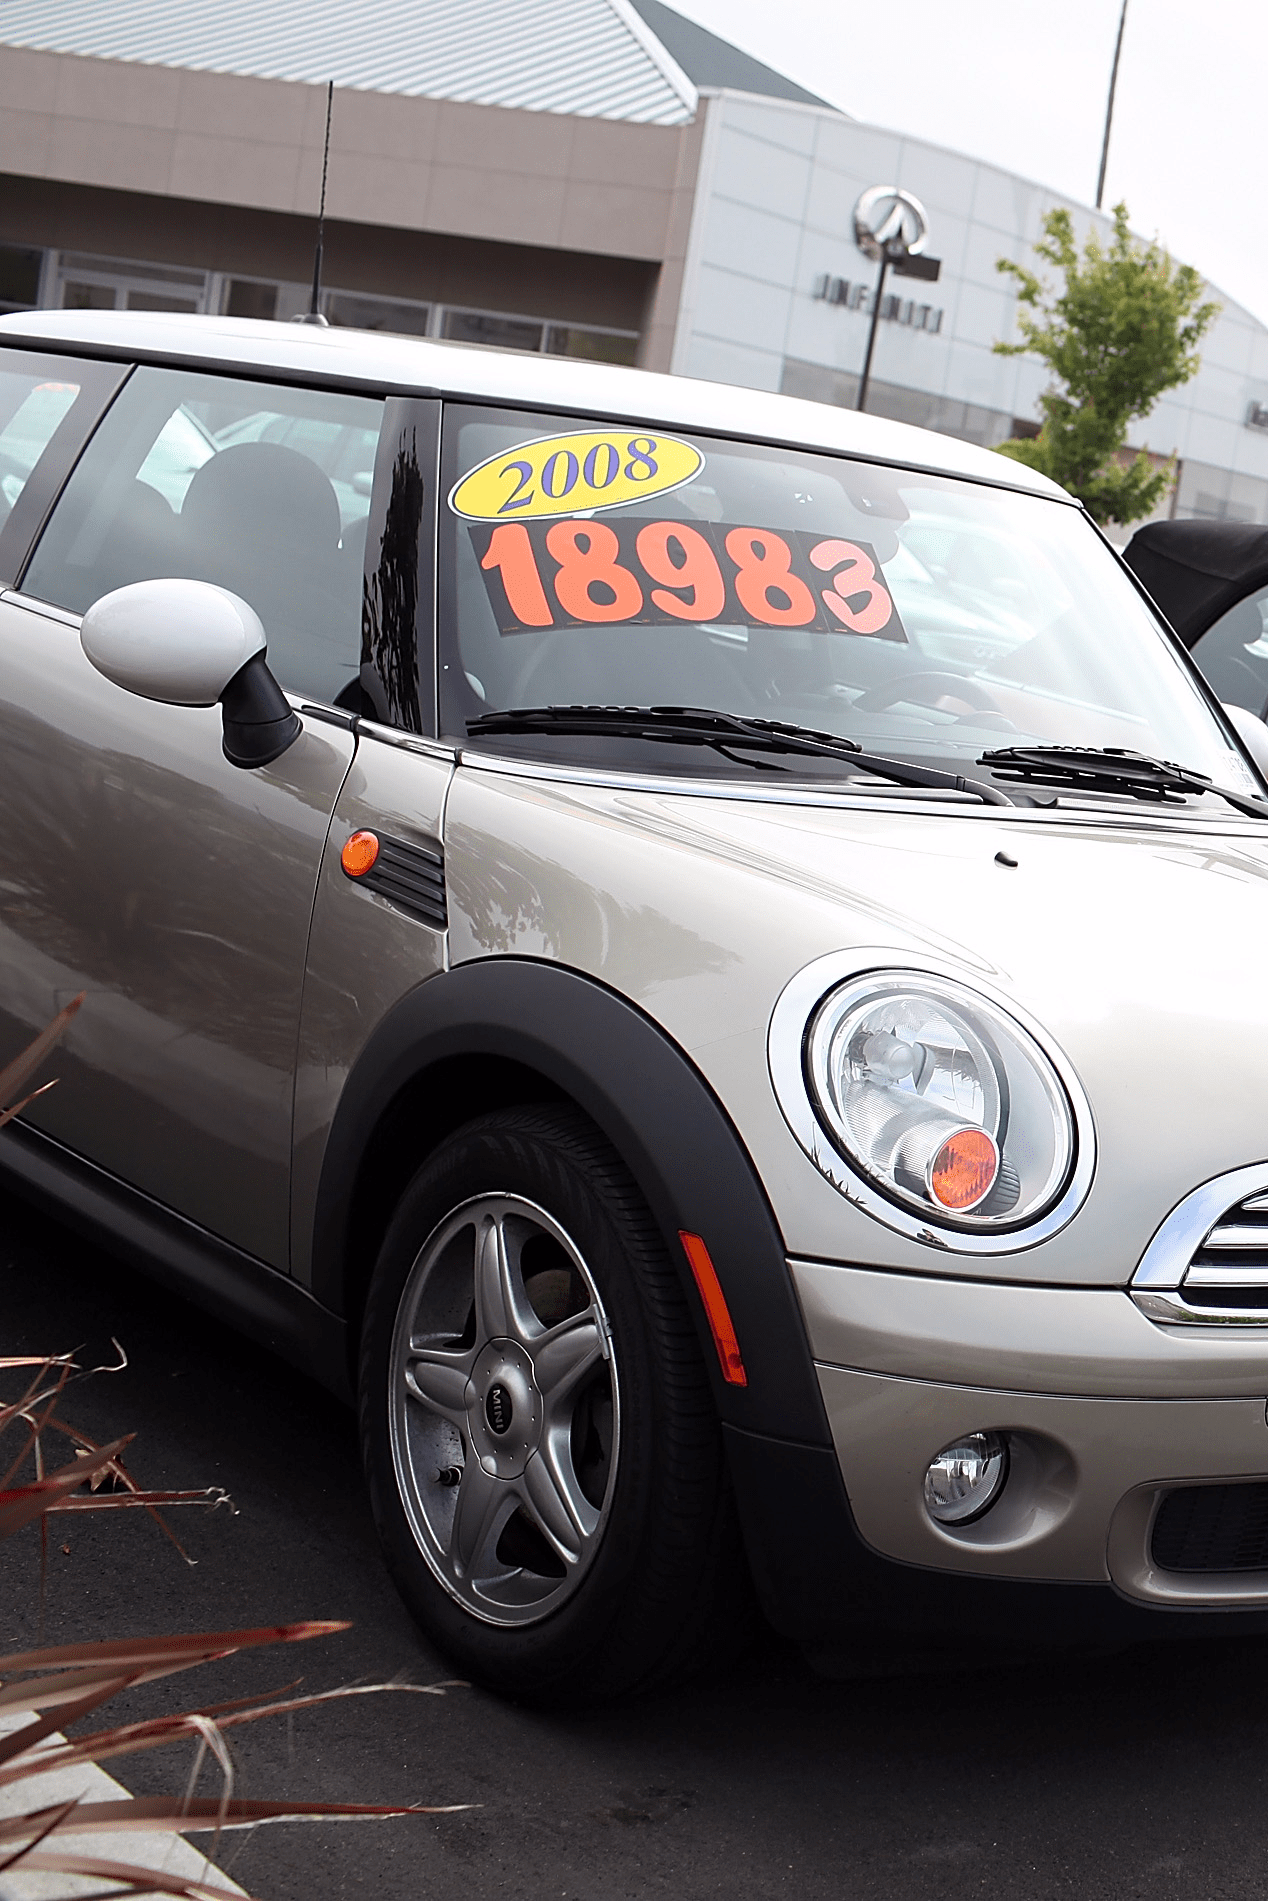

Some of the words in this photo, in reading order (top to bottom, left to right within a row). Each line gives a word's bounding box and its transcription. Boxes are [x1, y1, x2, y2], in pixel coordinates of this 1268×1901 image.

[813, 273, 943, 333] INFNITI
[497, 437, 659, 514] 2008
[481, 520, 893, 634] 18983
[492, 1389, 504, 1429] MINI
